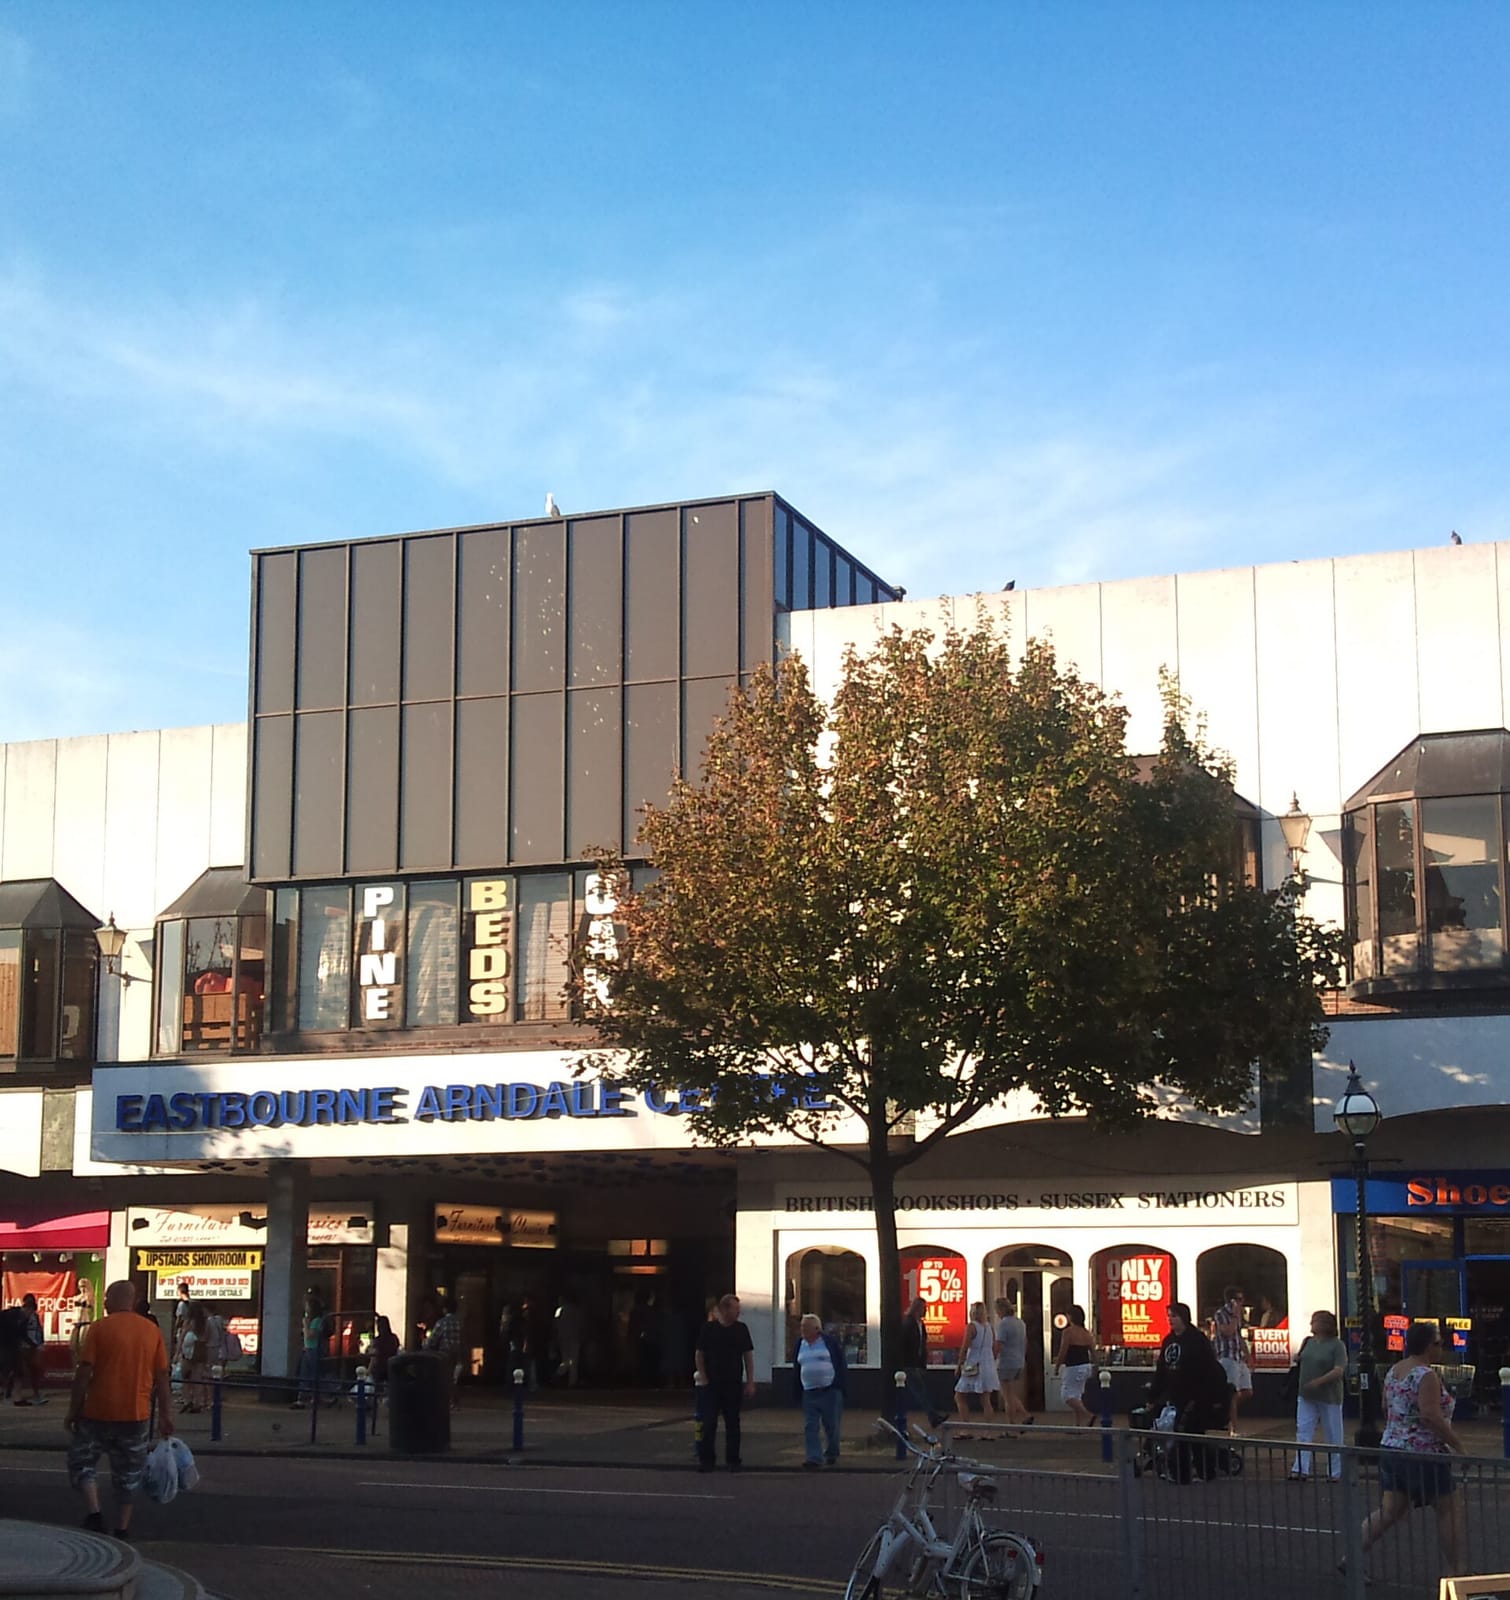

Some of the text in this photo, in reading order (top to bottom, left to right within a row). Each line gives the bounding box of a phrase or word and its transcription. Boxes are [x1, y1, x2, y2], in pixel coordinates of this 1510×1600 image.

[360, 886, 396, 1020] PINE
[469, 879, 508, 1015] BEDS
[115, 1087, 400, 1130] EASTBOURNE
[415, 1080, 628, 1121] ARNDALE
[785, 1195, 874, 1212] BRITISH
[1039, 1192, 1125, 1210] SUSSEX
[1138, 1189, 1285, 1209] STATIONERS
[146, 1252, 246, 1266] UPSTAIRS SHOWROOM
[1106, 1258, 1163, 1281] ONLY
[941, 1290, 963, 1302] OFF
[1107, 1281, 1163, 1301] £4.99
[38, 1297, 76, 1311] PRICE
[1122, 1303, 1150, 1320] ALL
[1254, 1329, 1289, 1340] EVERY
[1255, 1341, 1289, 1354] BOOK
